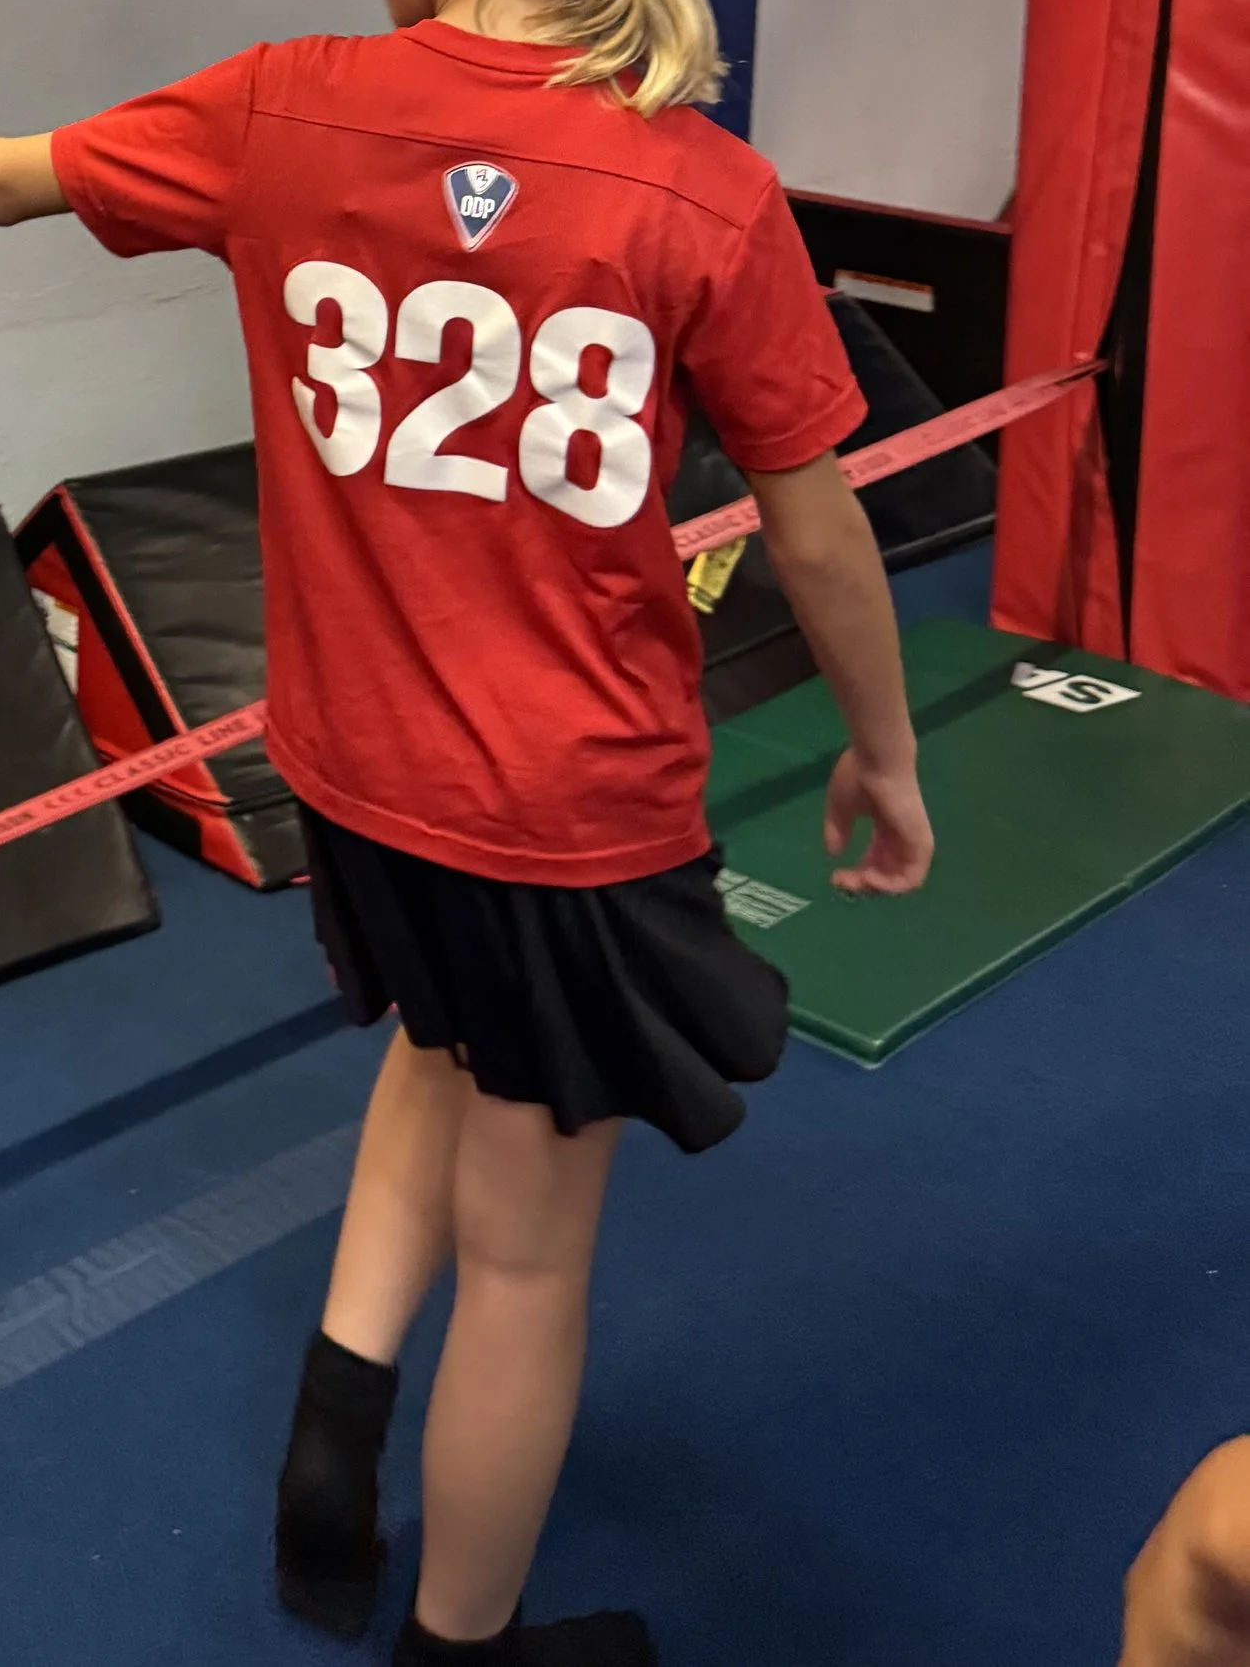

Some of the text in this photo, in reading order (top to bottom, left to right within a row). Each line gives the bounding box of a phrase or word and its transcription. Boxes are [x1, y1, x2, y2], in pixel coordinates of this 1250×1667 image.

[460, 195, 496, 219] ODP
[283, 260, 656, 529] 328
[96, 741, 191, 788] CLASSIC
